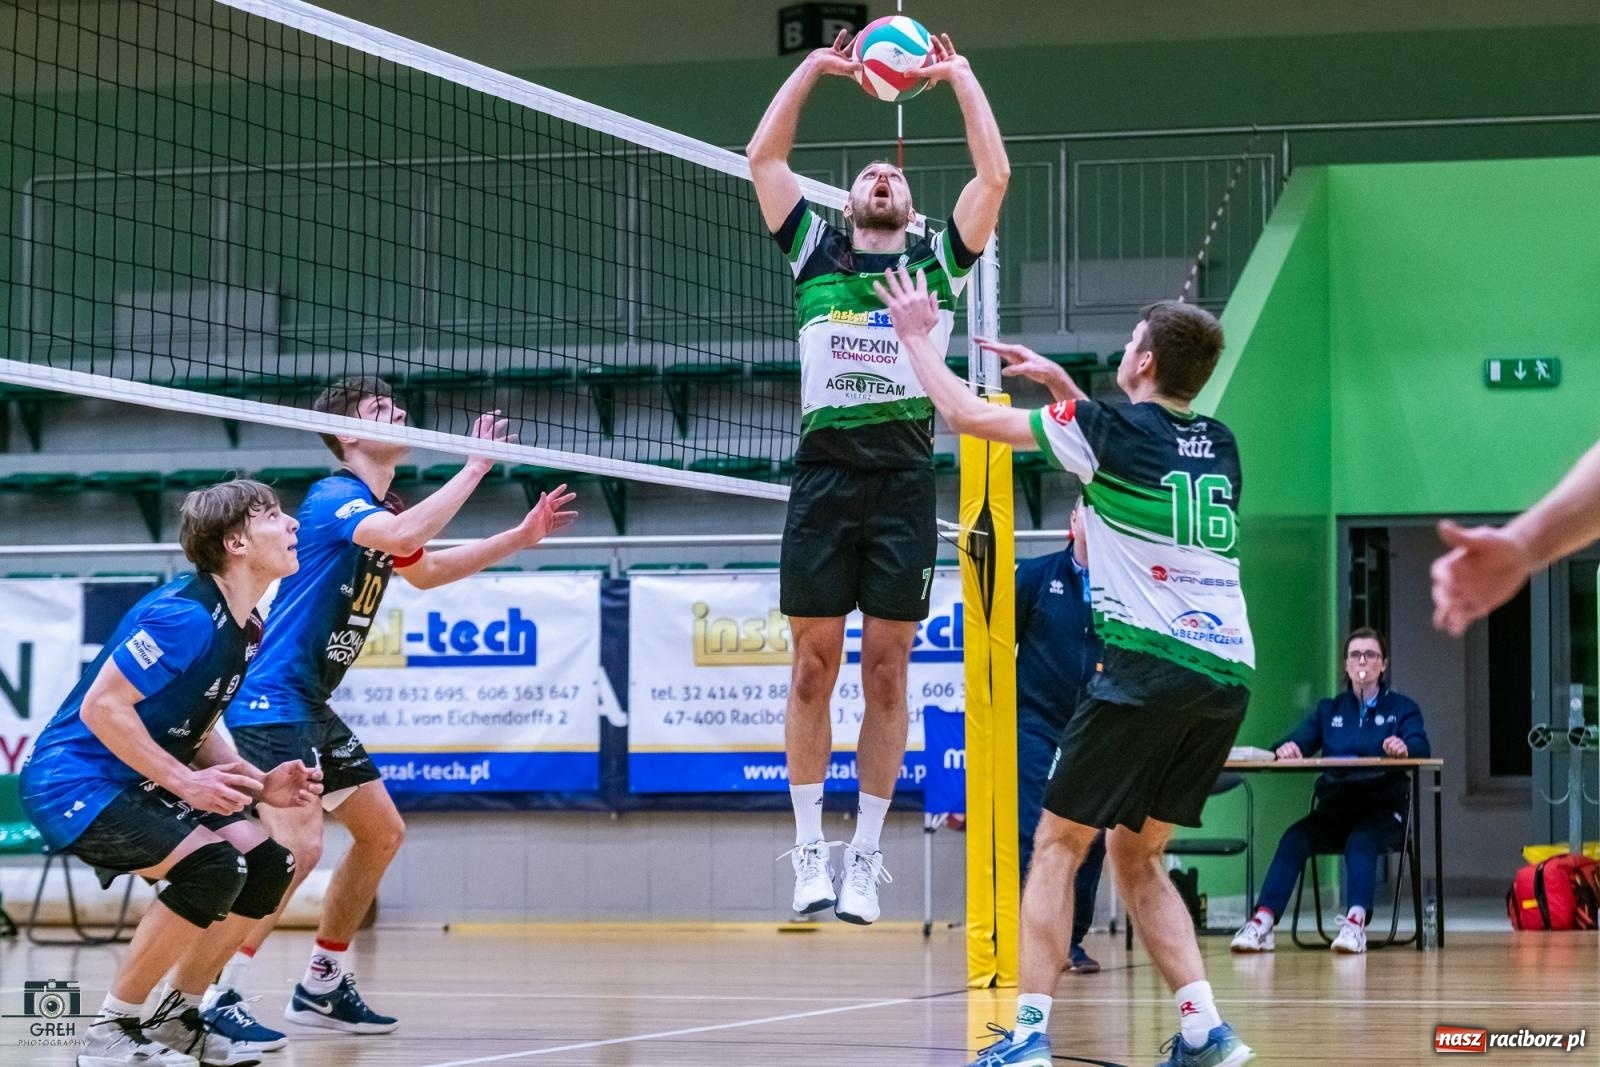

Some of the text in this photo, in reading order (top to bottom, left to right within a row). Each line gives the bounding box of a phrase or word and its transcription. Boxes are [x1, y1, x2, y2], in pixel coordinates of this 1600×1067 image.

[831, 335, 899, 355] PIVEXIN
[832, 350, 898, 364] TECHNOLOGY
[1175, 435, 1216, 458] RÓŻ
[1161, 470, 1235, 552] 16
[352, 572, 382, 615] 10
[921, 568, 932, 600] 7
[1171, 627, 1243, 644] UBEZPIECZENIA
[364, 686, 393, 701] 502
[399, 685, 428, 700] 632
[477, 686, 507, 700] 606
[514, 686, 544, 699] 363
[550, 685, 579, 699] 647
[651, 686, 676, 700] tel.
[681, 686, 702, 702] 32
[707, 686, 738, 700] 414
[742, 686, 764, 700] 92
[839, 683, 861, 699] 63
[922, 683, 955, 698] 606
[413, 714, 442, 726] von
[448, 710, 552, 726] Eichendorffa
[558, 711, 568, 725] 2
[663, 710, 726, 725] 47-400
[731, 709, 786, 725] Racibó
